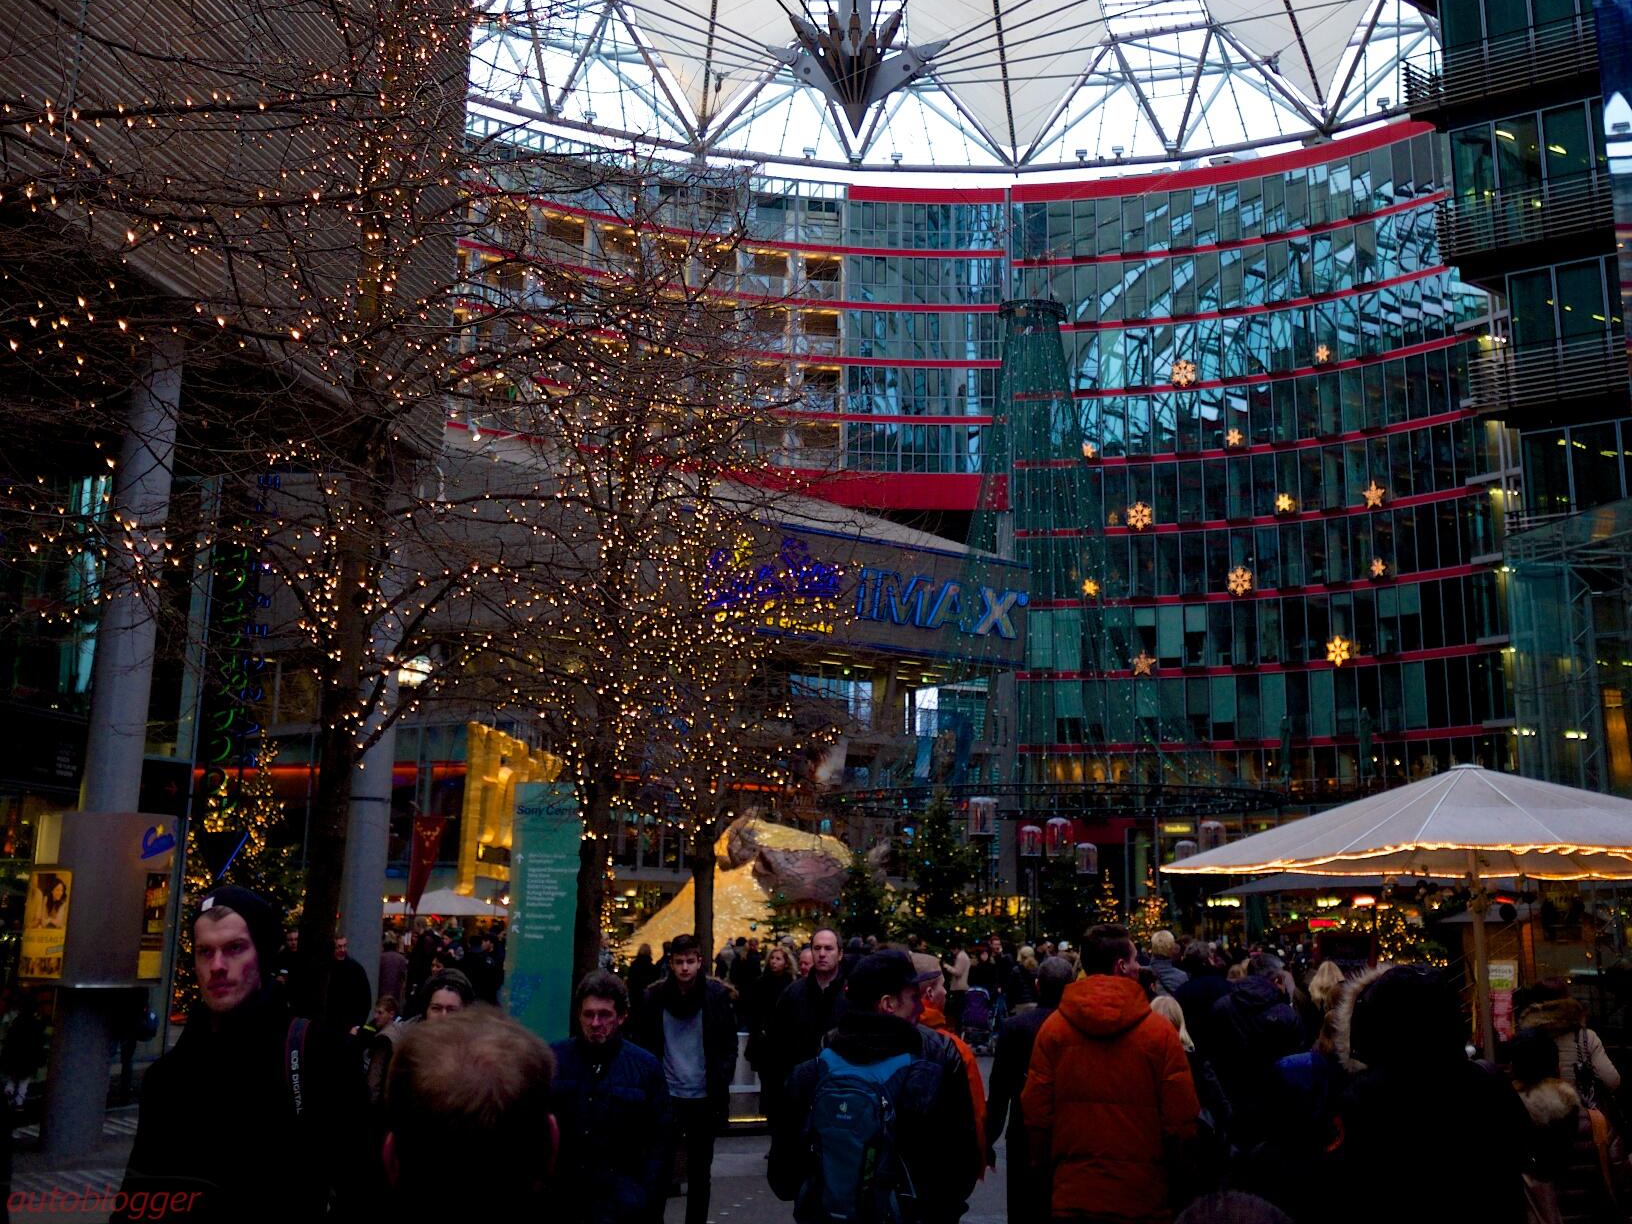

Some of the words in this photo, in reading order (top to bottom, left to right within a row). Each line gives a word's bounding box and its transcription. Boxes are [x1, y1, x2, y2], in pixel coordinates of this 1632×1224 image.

[517, 806, 545, 817] Sony
[291, 1049, 300, 1071] EOS
[292, 1073, 304, 1116] DIGITAL
